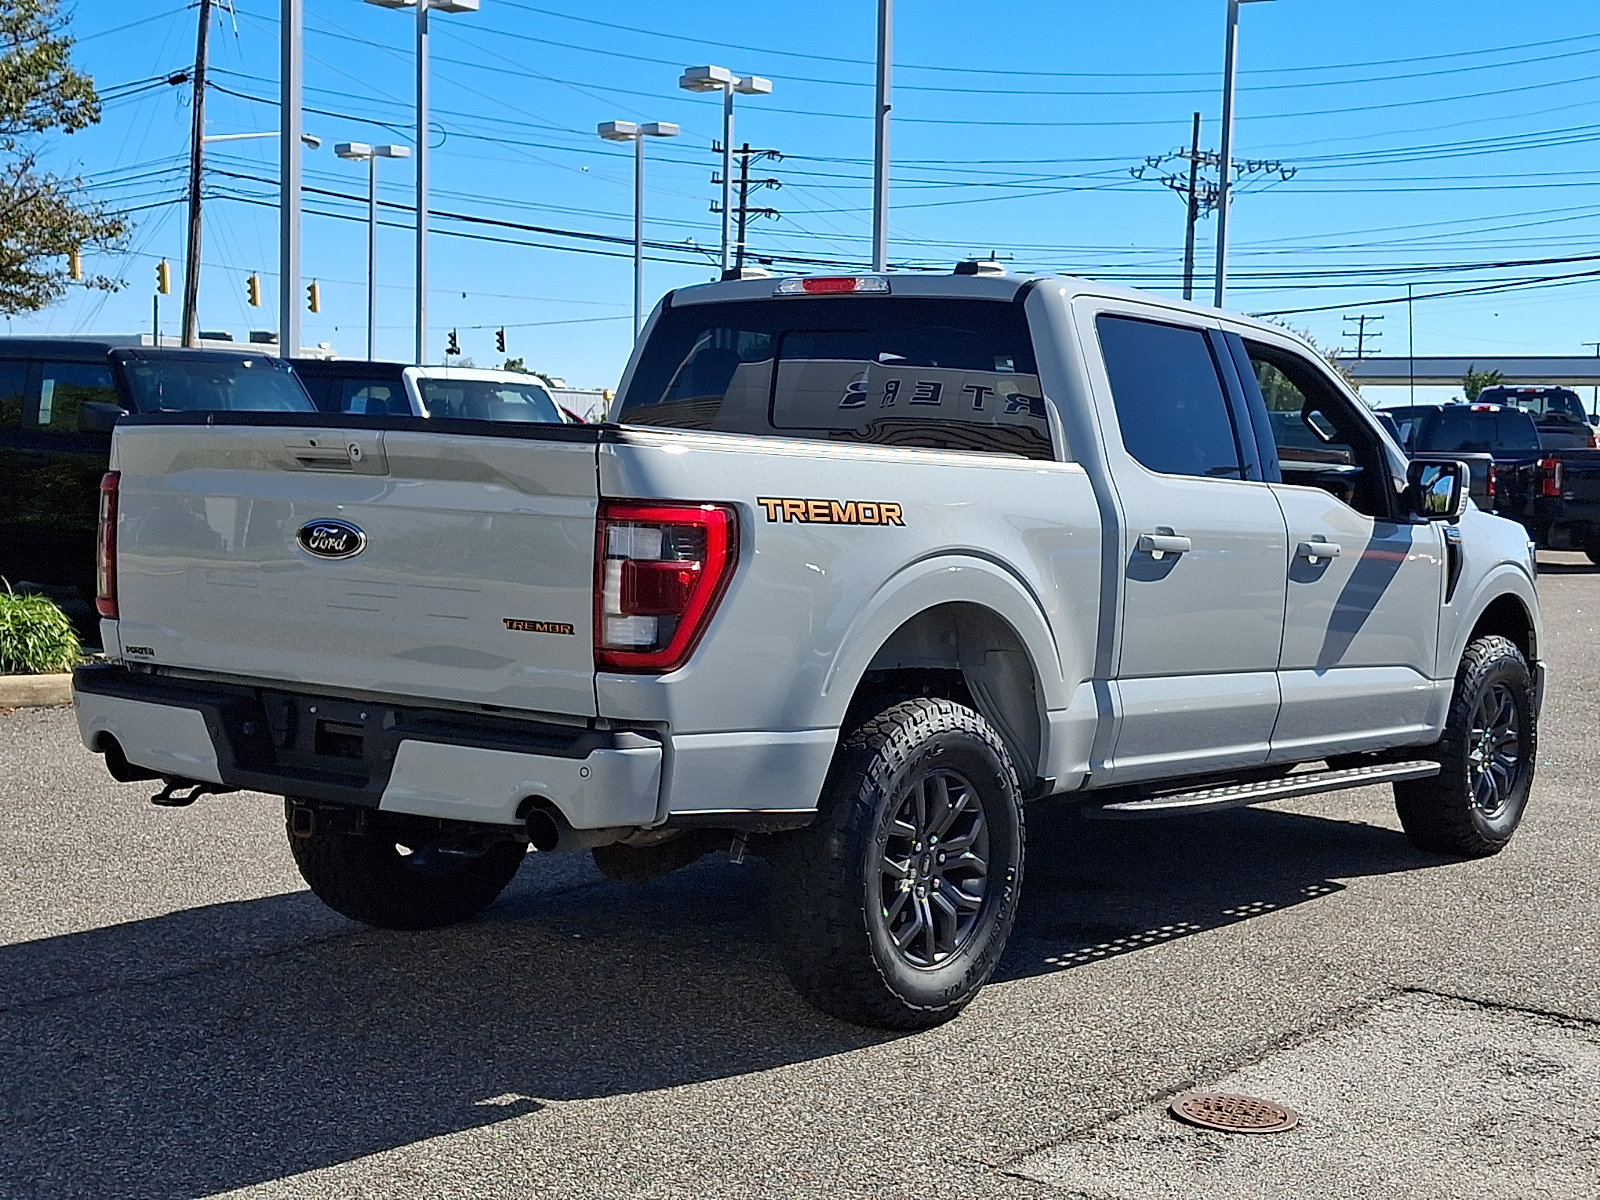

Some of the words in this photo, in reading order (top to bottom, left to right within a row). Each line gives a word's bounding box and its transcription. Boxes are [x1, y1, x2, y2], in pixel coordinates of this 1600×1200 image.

[756, 497, 906, 526] TREMOR
[309, 526, 348, 551] Ford
[503, 618, 575, 635] TREMOR
[125, 645, 156, 657] PORTER
